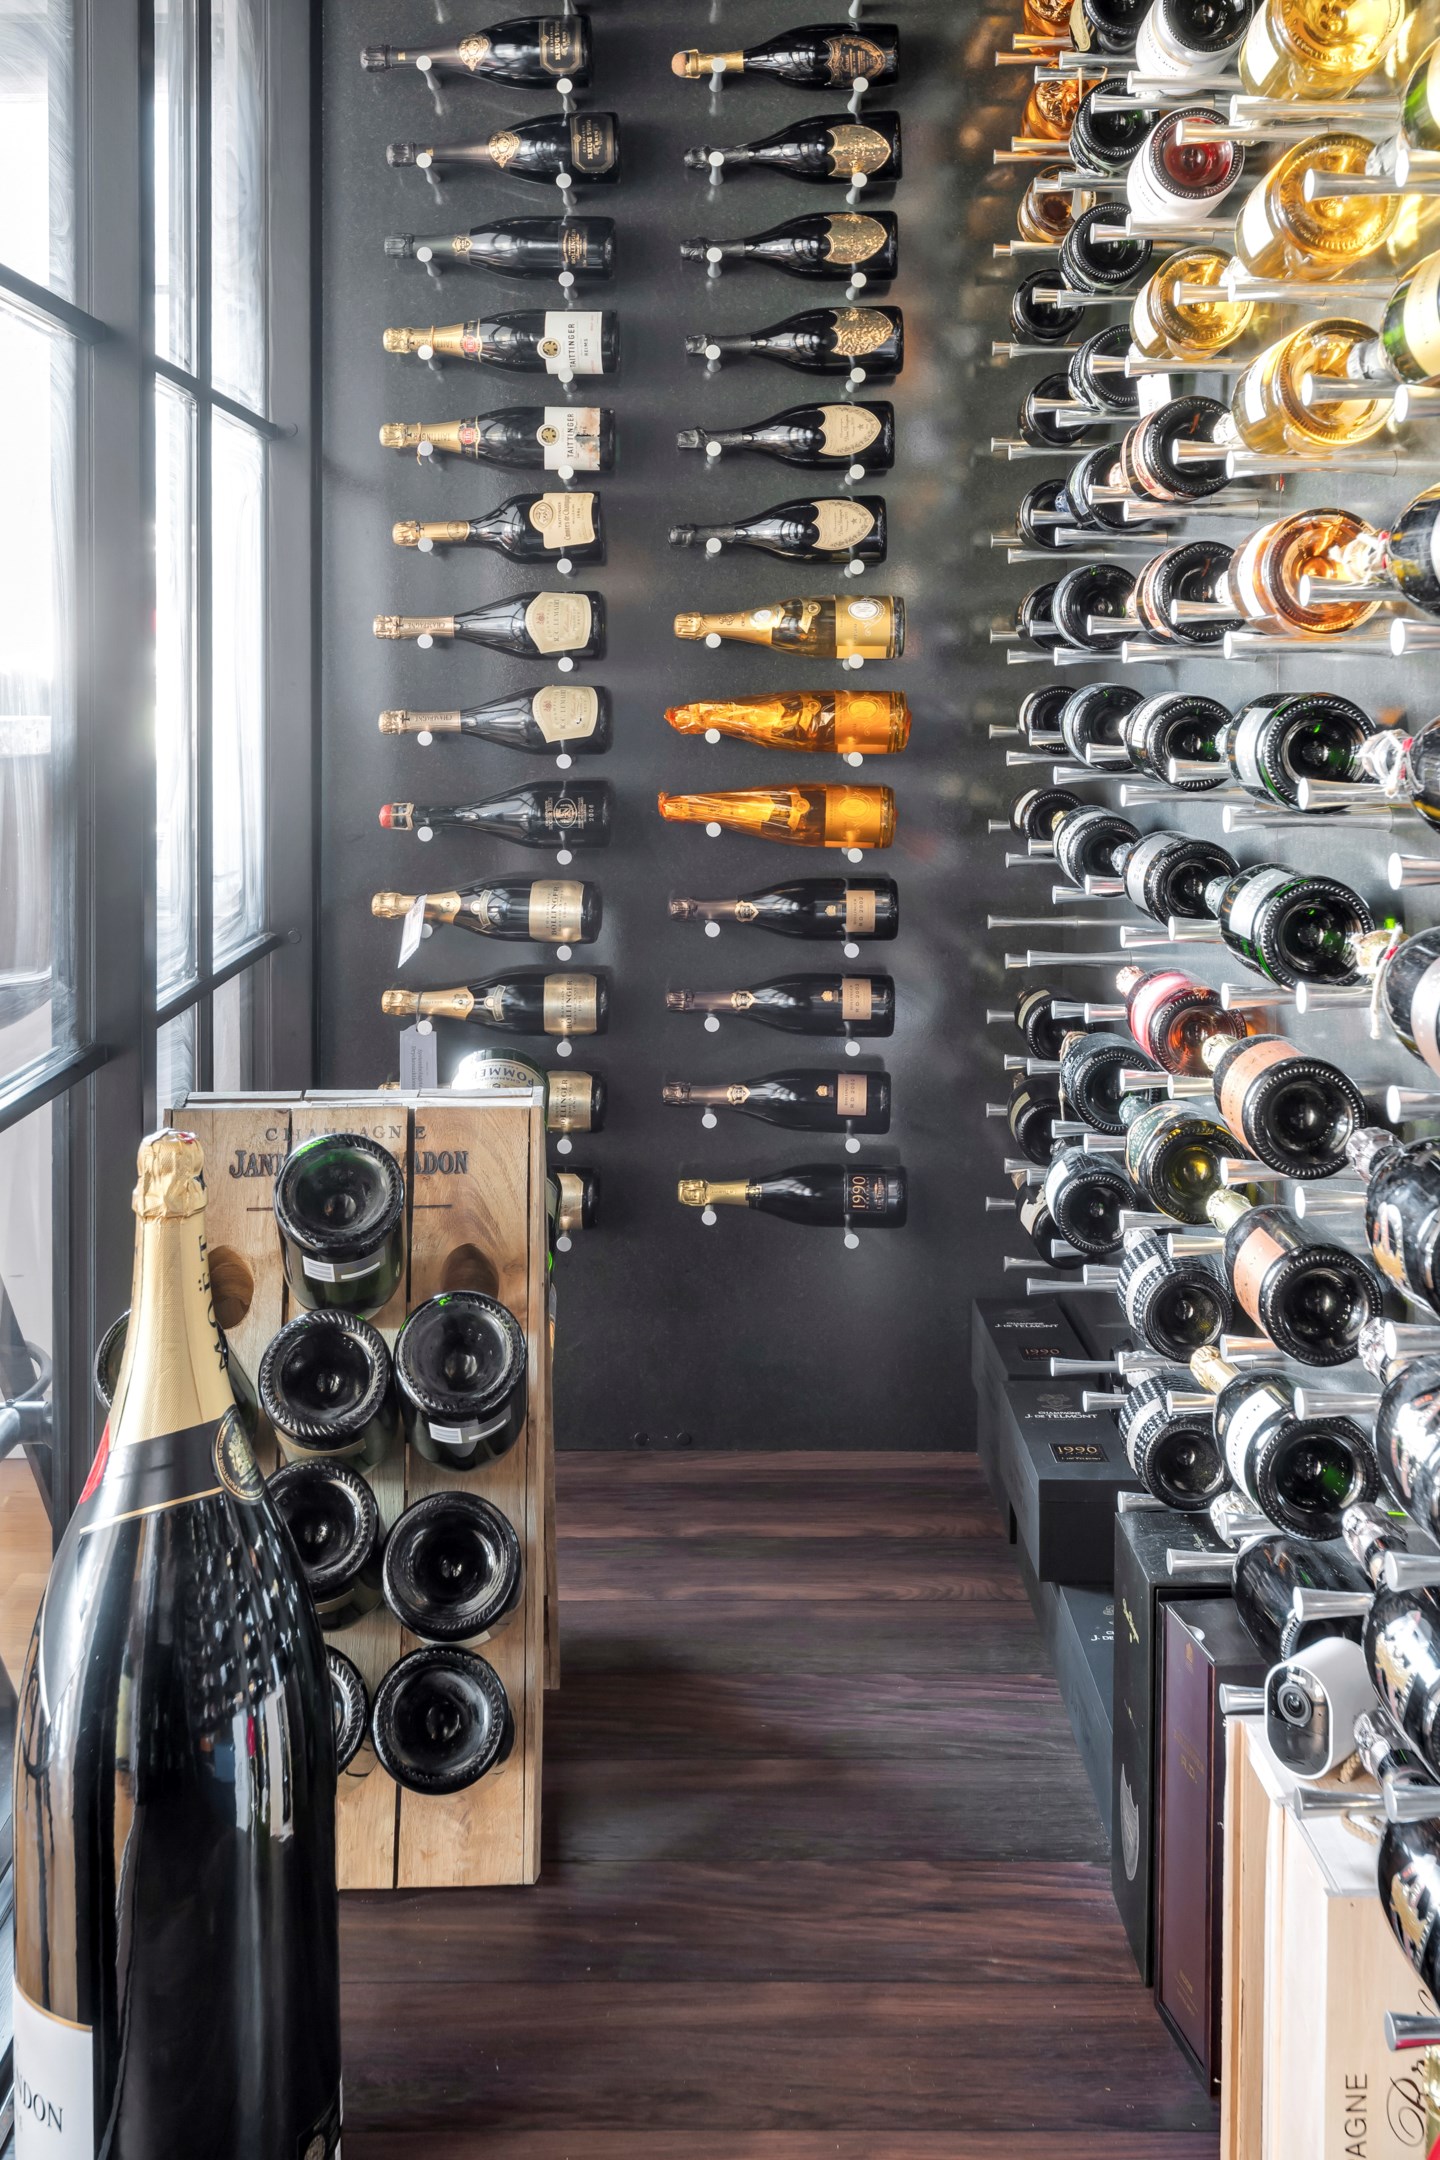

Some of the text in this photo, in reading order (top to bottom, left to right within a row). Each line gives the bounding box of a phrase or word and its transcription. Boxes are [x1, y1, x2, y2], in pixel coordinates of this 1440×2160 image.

[568, 323, 576, 368] TAITTINGER
[566, 413, 575, 458] TAITTINGER
[551, 886, 560, 936] BOLLINGER
[560, 1079, 569, 1128] BOLLINGER
[852, 1176, 866, 1209] 1990
[218, 1449, 223, 1458] OF
[1057, 1446, 1098, 1454] 1990
[1344, 2073, 1367, 2159] AGNE
